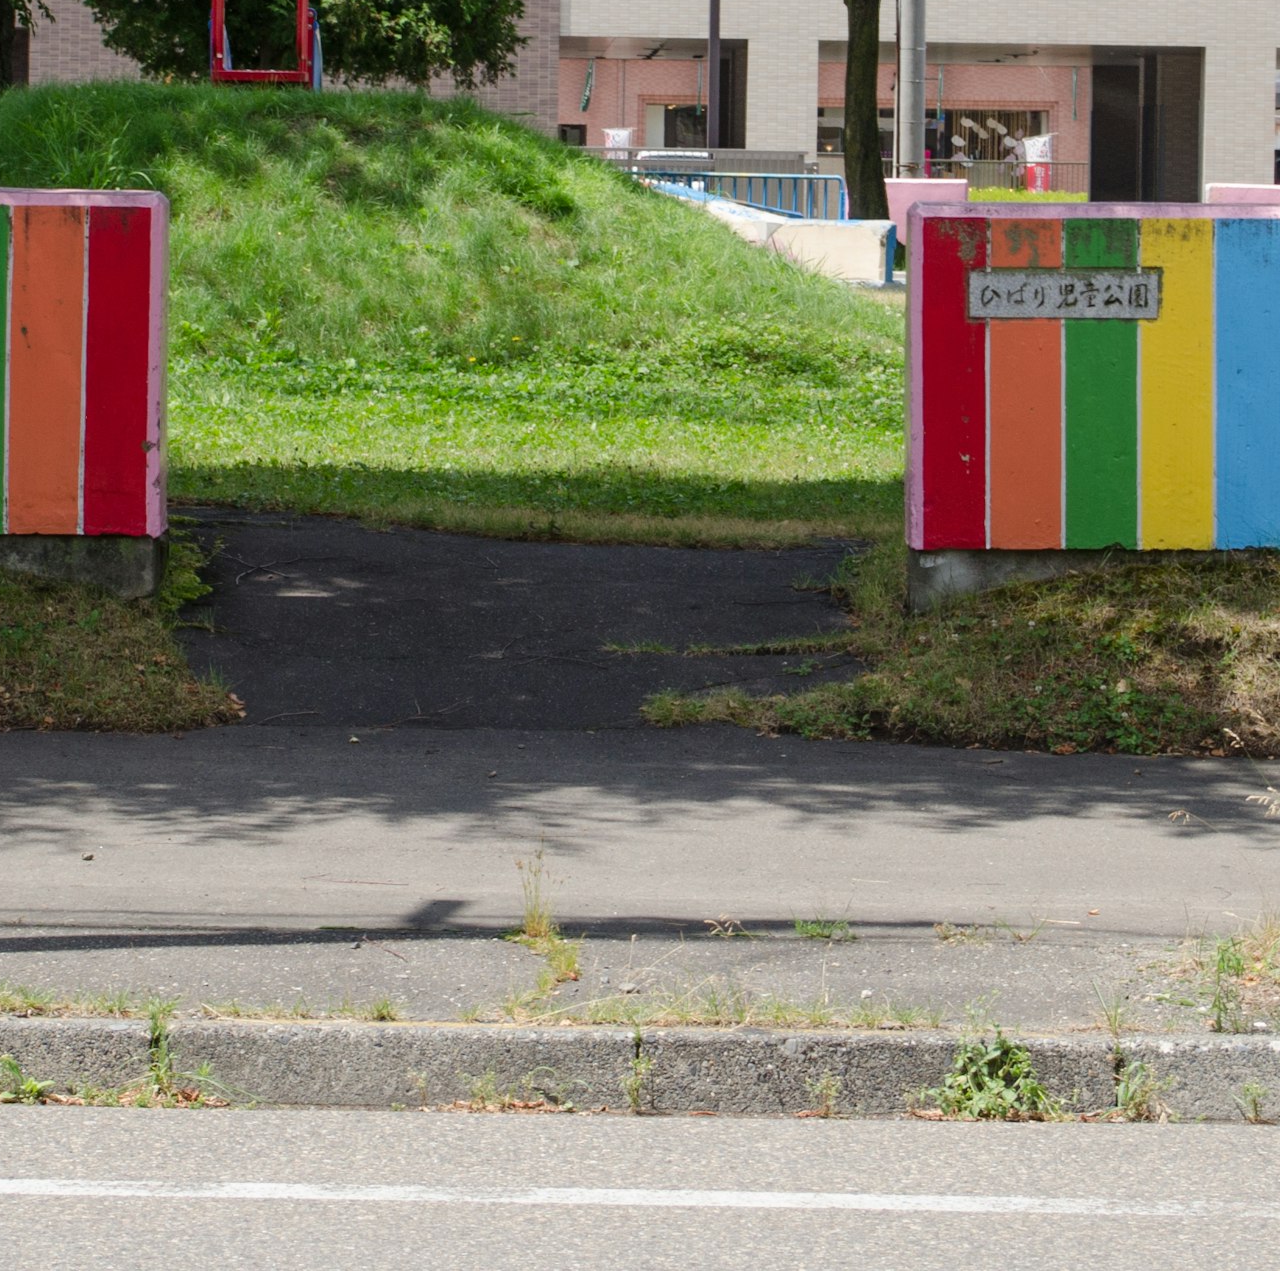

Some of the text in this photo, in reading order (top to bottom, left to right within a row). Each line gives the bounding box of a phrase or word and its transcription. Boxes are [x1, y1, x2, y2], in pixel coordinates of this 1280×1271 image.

[980, 283, 1150, 310] ひばり児童公園
